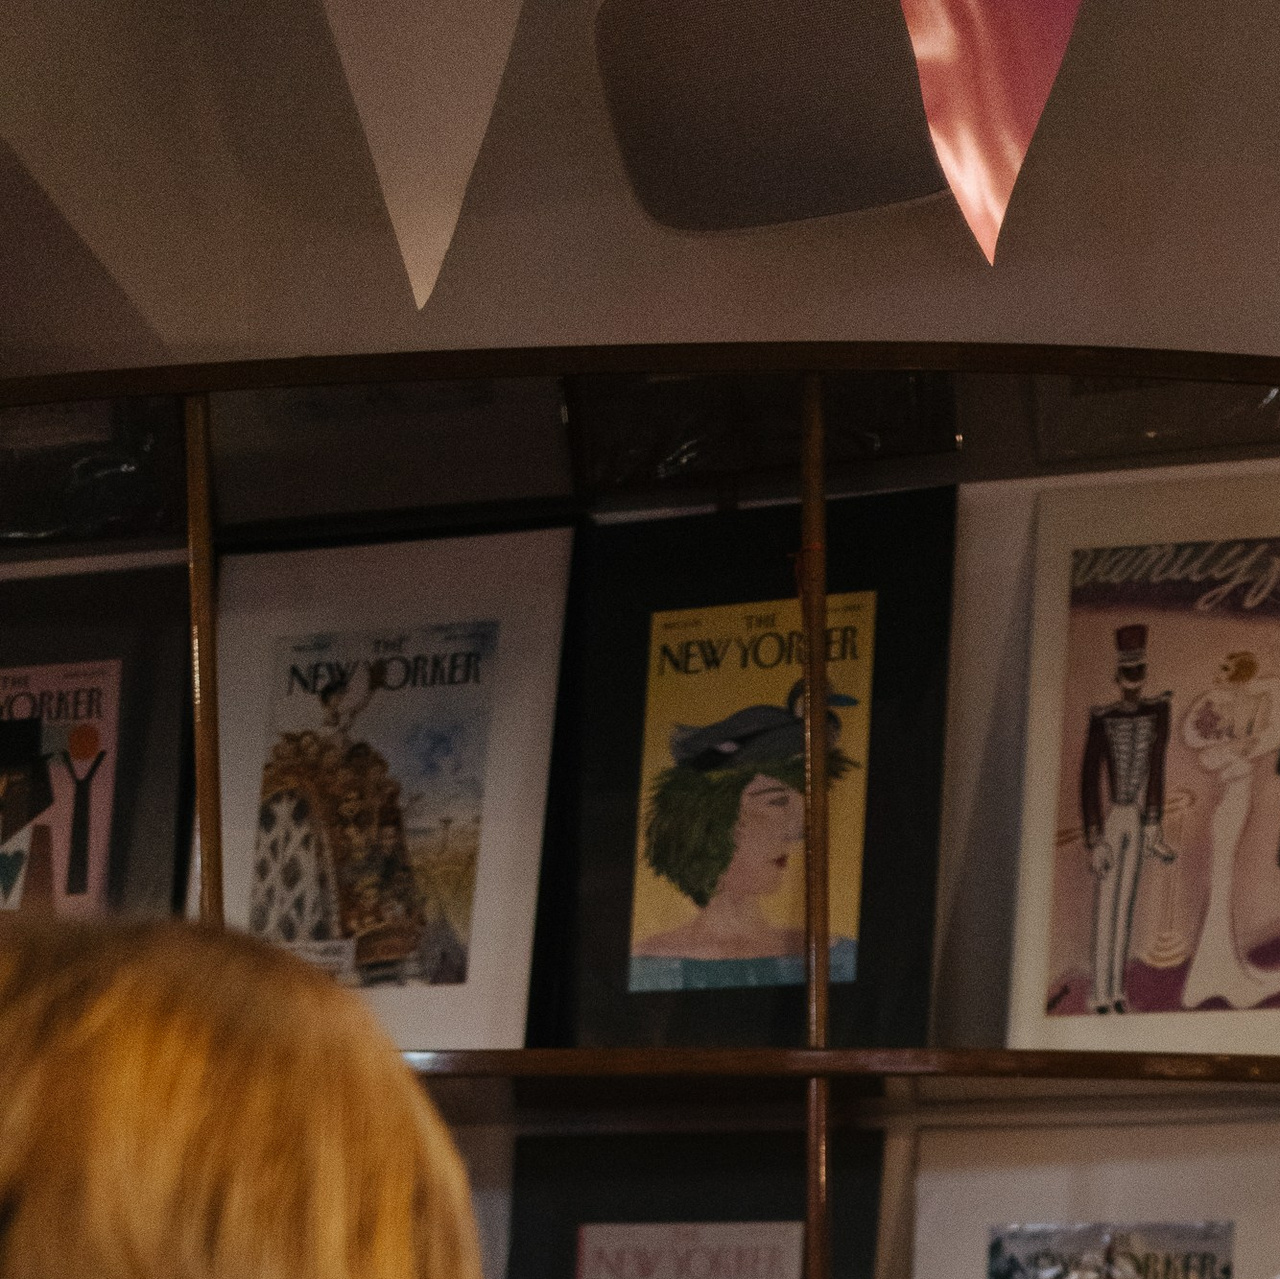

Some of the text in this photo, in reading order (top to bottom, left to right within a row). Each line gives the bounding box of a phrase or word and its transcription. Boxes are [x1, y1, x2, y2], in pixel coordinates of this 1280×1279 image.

[657, 625, 859, 677] NEW YORER
[287, 660, 358, 696] NEW
